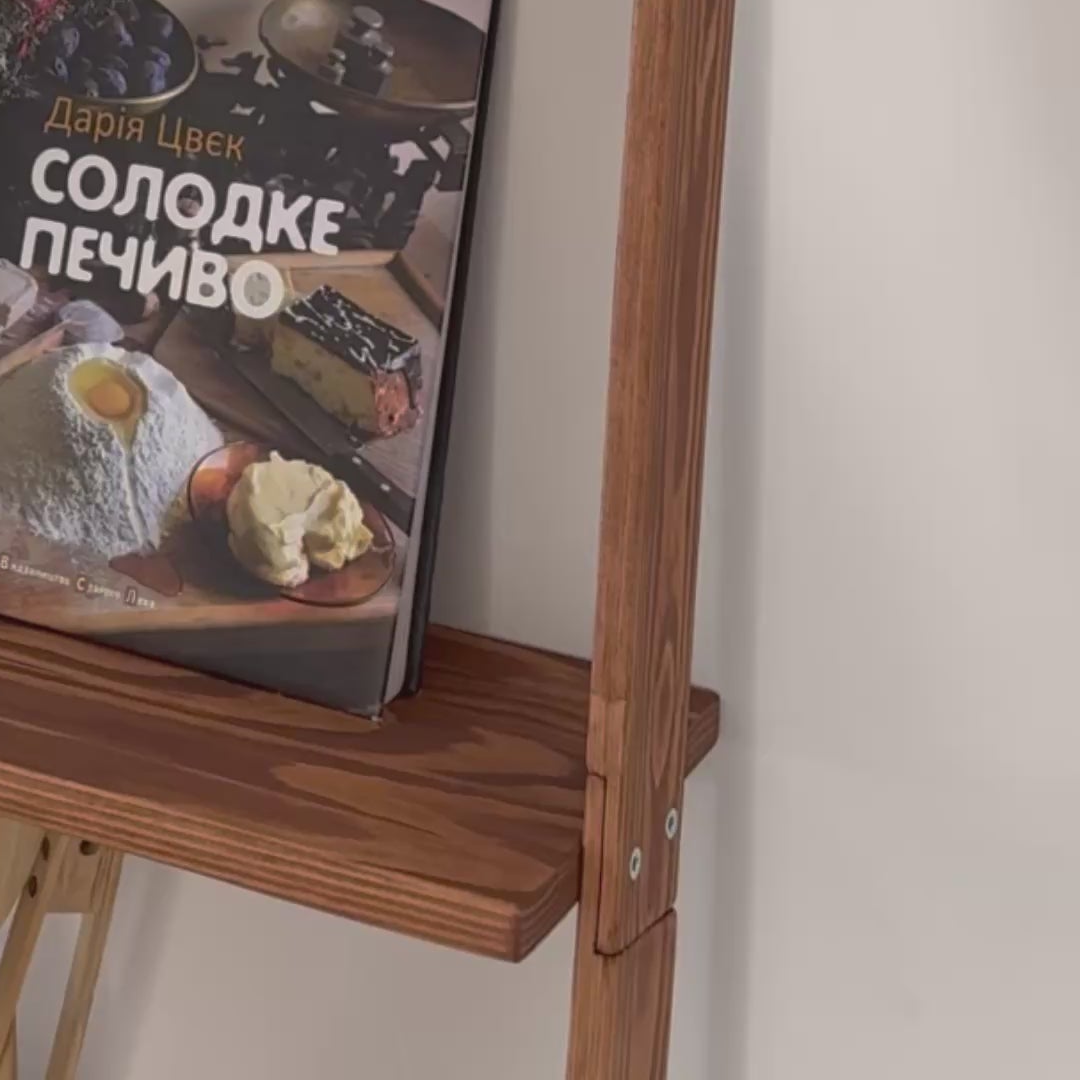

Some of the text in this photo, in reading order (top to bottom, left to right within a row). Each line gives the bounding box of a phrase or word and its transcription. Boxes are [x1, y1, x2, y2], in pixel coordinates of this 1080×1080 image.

[43, 95, 246, 162] Дарія Цвєк
[30, 147, 346, 257] СОЛОДКЕ
[19, 216, 286, 320] ПЕЧИВО
